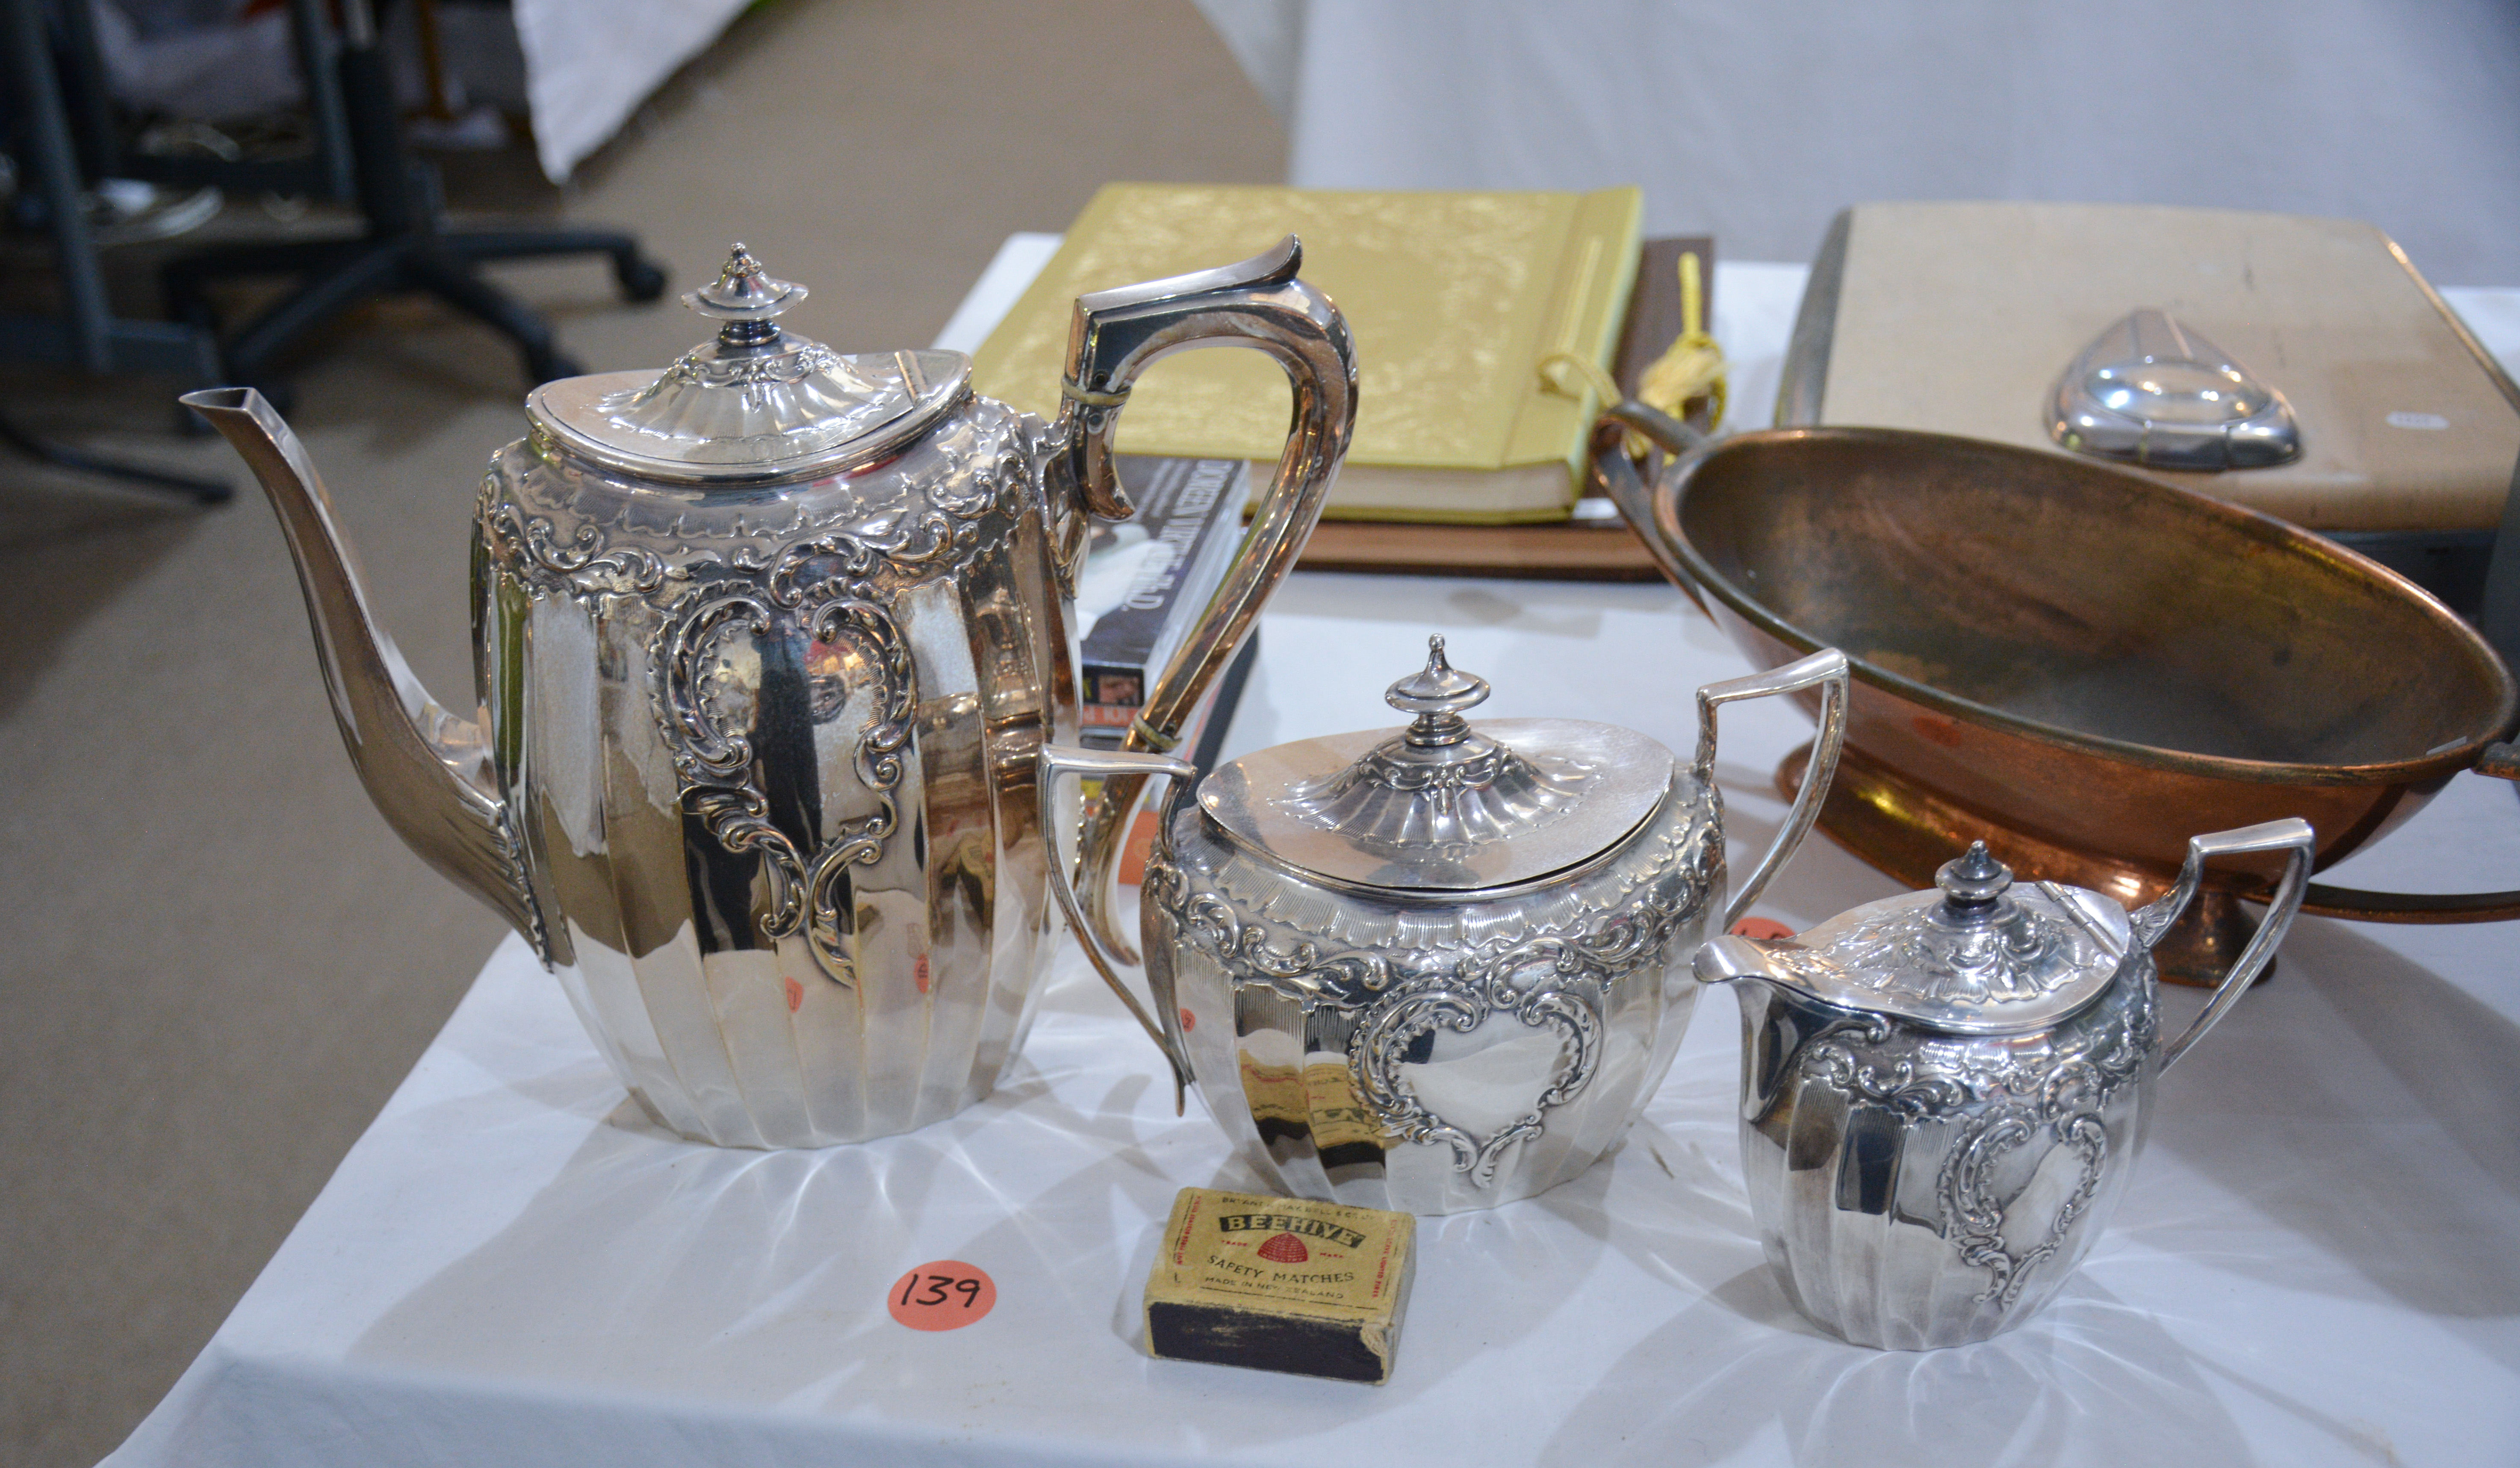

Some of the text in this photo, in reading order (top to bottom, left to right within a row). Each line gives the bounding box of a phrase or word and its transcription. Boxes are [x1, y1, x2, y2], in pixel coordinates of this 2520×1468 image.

[1228, 1215, 1357, 1245] BEEHIVE
[1207, 1255, 1354, 1283] SAFETY MATCHES
[901, 1273, 980, 1308] 139
[1205, 1276, 1236, 1286] MADE
[1286, 1286, 1344, 1299] ZEALAND
